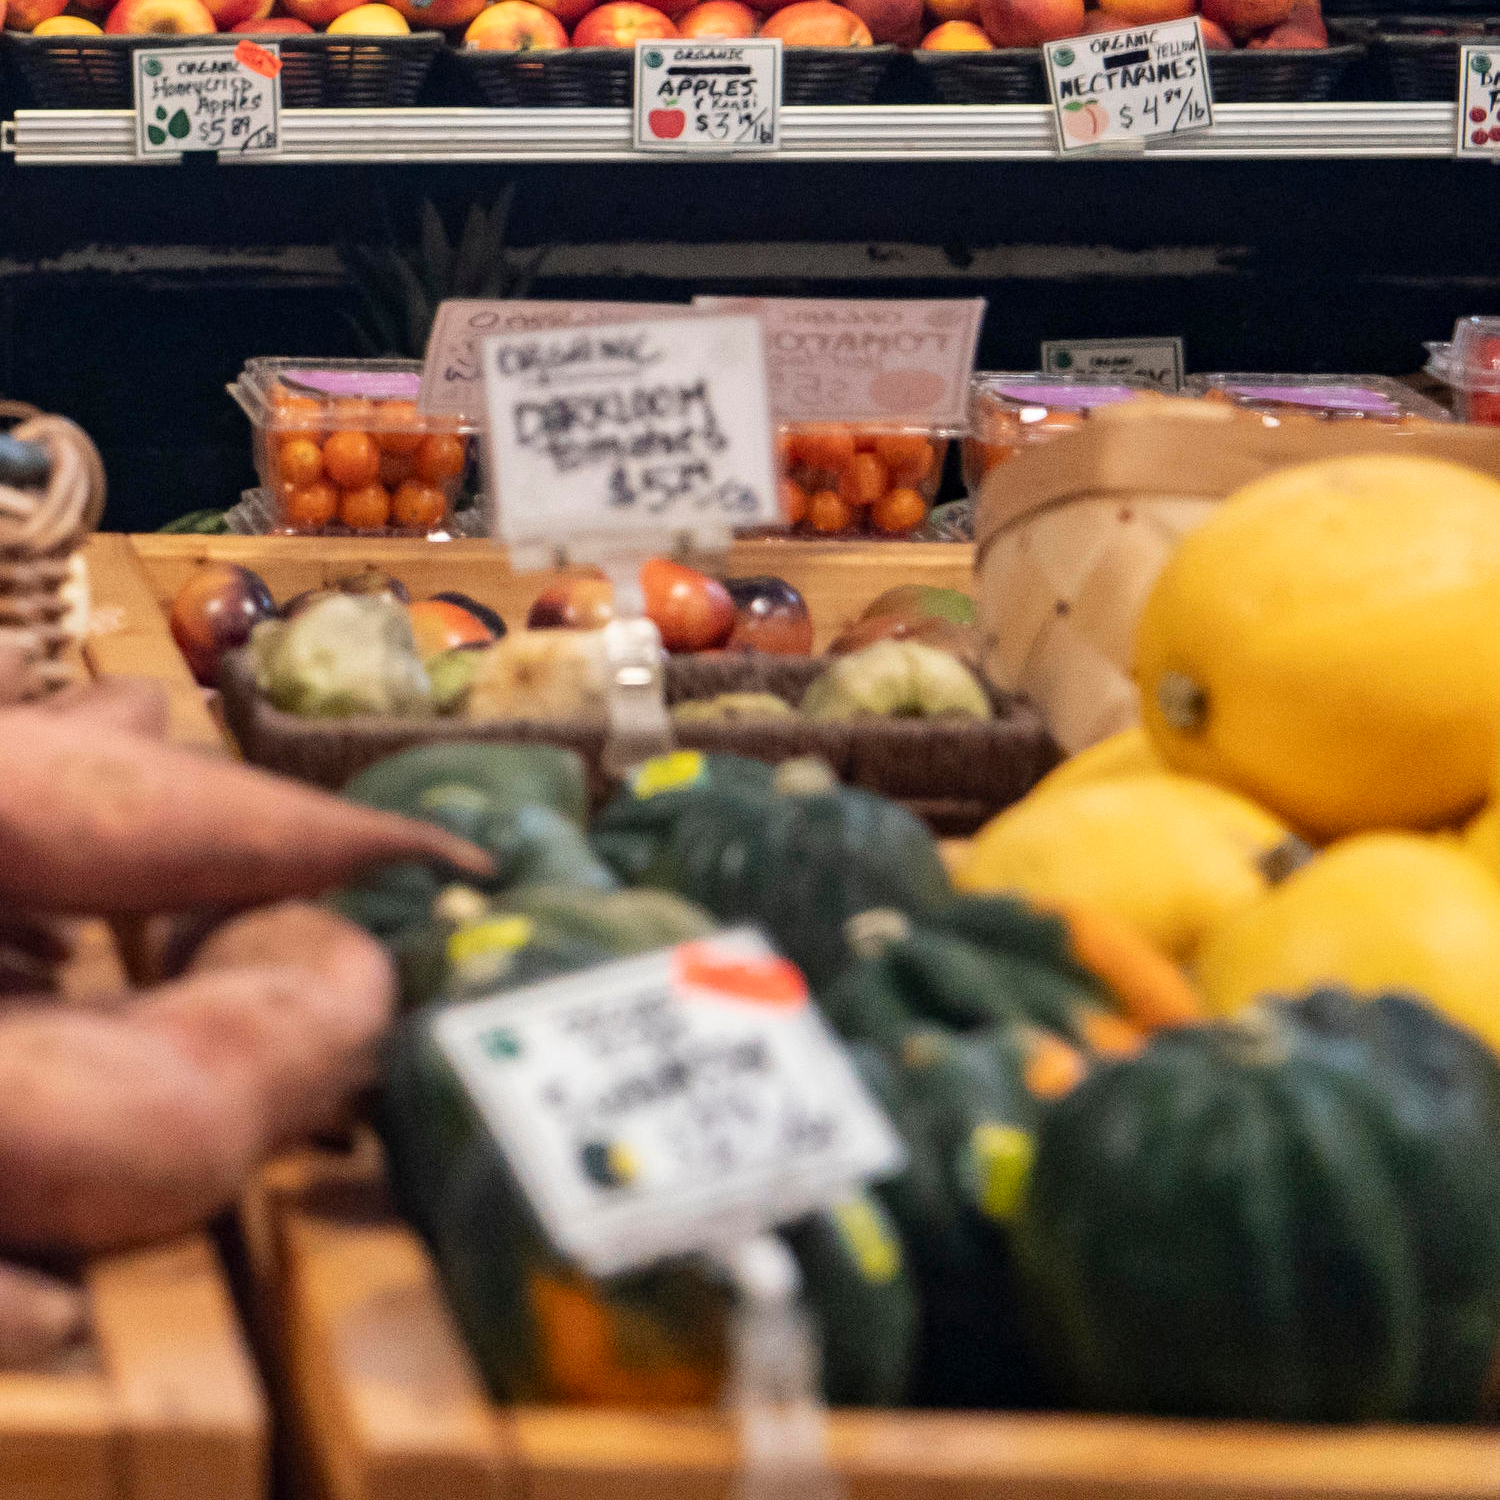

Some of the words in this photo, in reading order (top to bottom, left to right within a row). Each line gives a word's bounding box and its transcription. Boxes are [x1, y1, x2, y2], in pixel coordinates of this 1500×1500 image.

[1089, 29, 1160, 53] ORGANIC
[673, 47, 745, 61] ORGANIC
[657, 78, 758, 97] APPLES
[1060, 57, 1197, 100] NECTARINES
